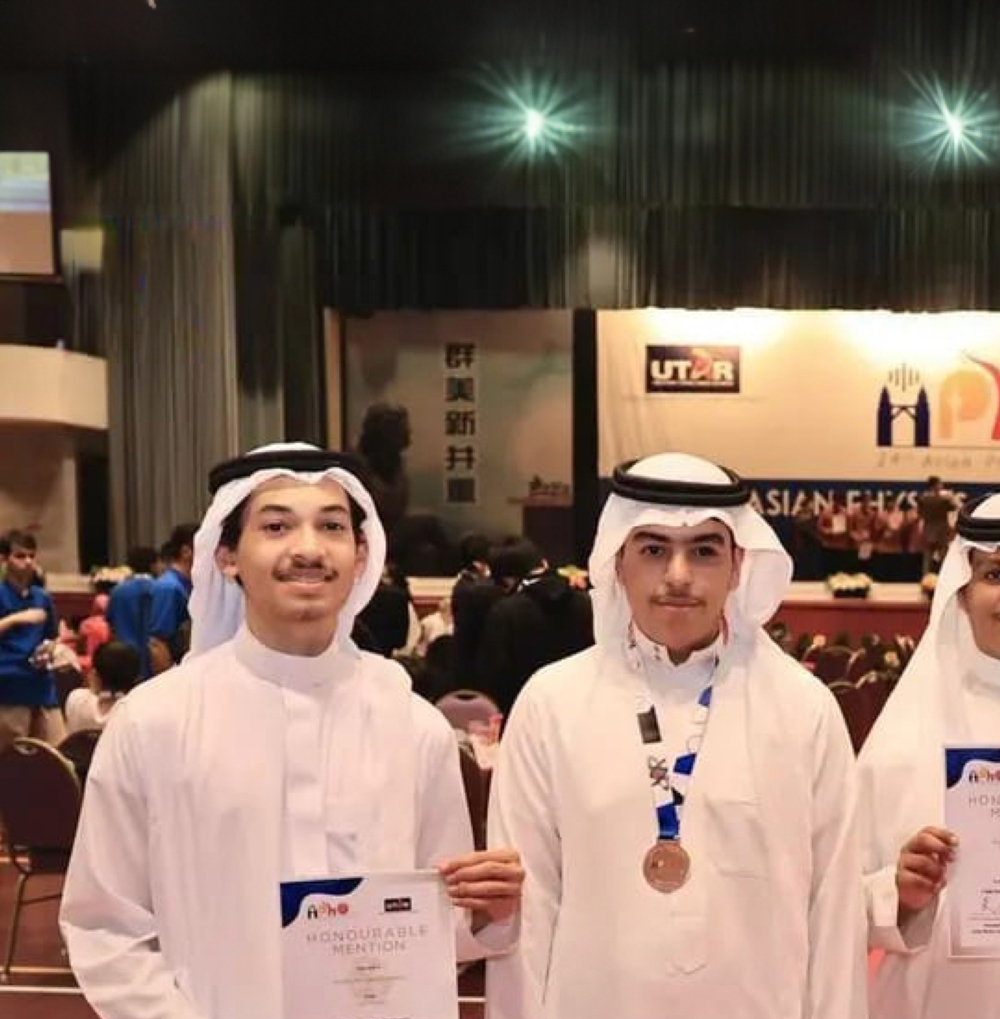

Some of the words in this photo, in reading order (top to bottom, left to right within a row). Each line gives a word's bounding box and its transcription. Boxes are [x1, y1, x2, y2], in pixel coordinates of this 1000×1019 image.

[651, 360, 734, 380] UTAR
[306, 924, 429, 943] HONOURABLE
[332, 940, 406, 955] MENTION
